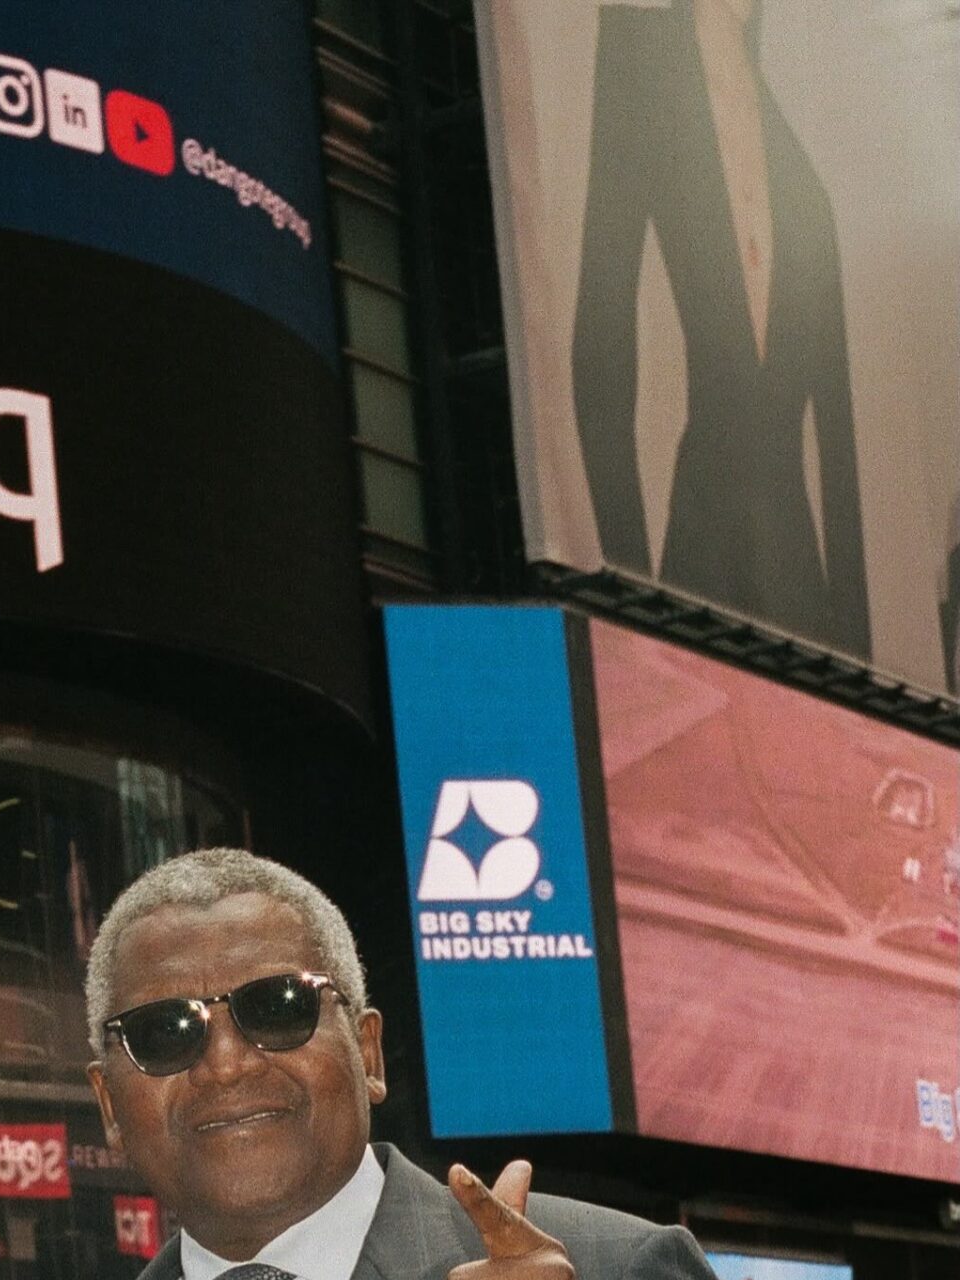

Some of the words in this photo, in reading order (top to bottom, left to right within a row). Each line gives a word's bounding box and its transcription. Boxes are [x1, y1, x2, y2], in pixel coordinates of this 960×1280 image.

[419, 911, 470, 934] BIG
[476, 910, 532, 933] SKY
[421, 934, 593, 960] INDUSTRIAL
